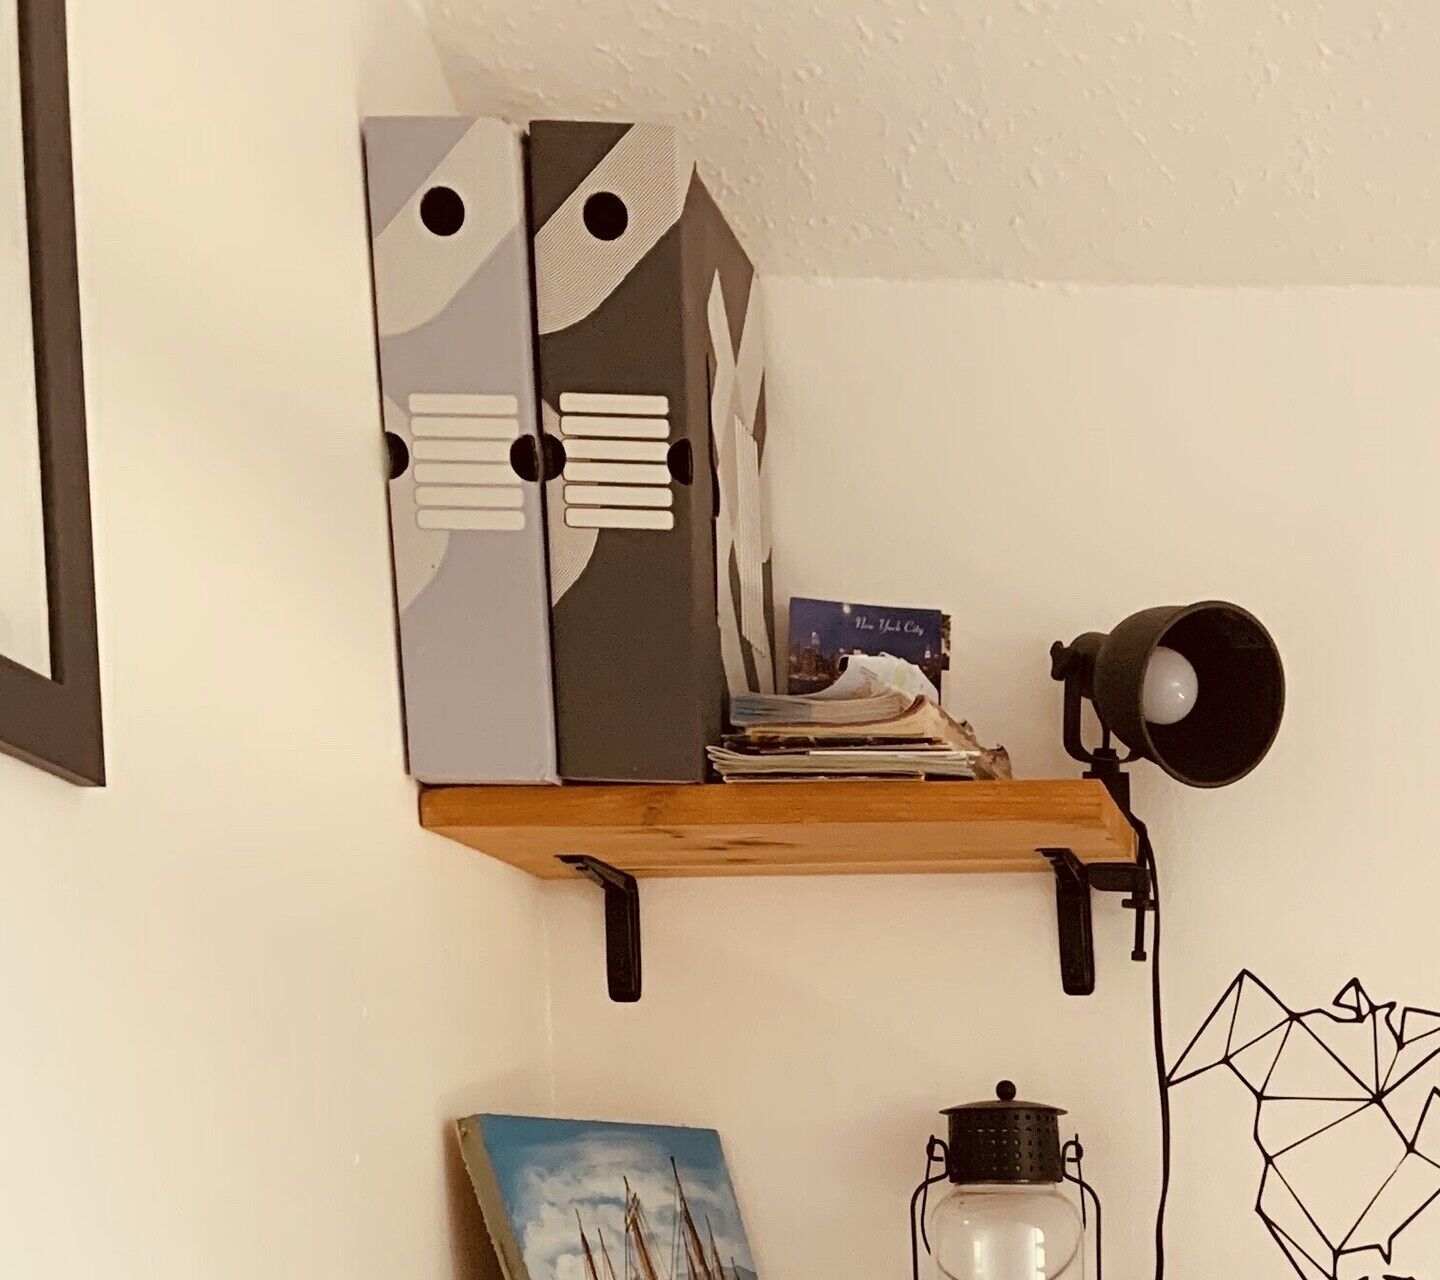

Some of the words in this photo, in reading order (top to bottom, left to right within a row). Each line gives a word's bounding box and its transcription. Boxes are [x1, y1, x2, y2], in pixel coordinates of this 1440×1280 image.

[855, 616, 875, 630] New
[879, 617, 901, 634] York
[903, 619, 924, 637] City
